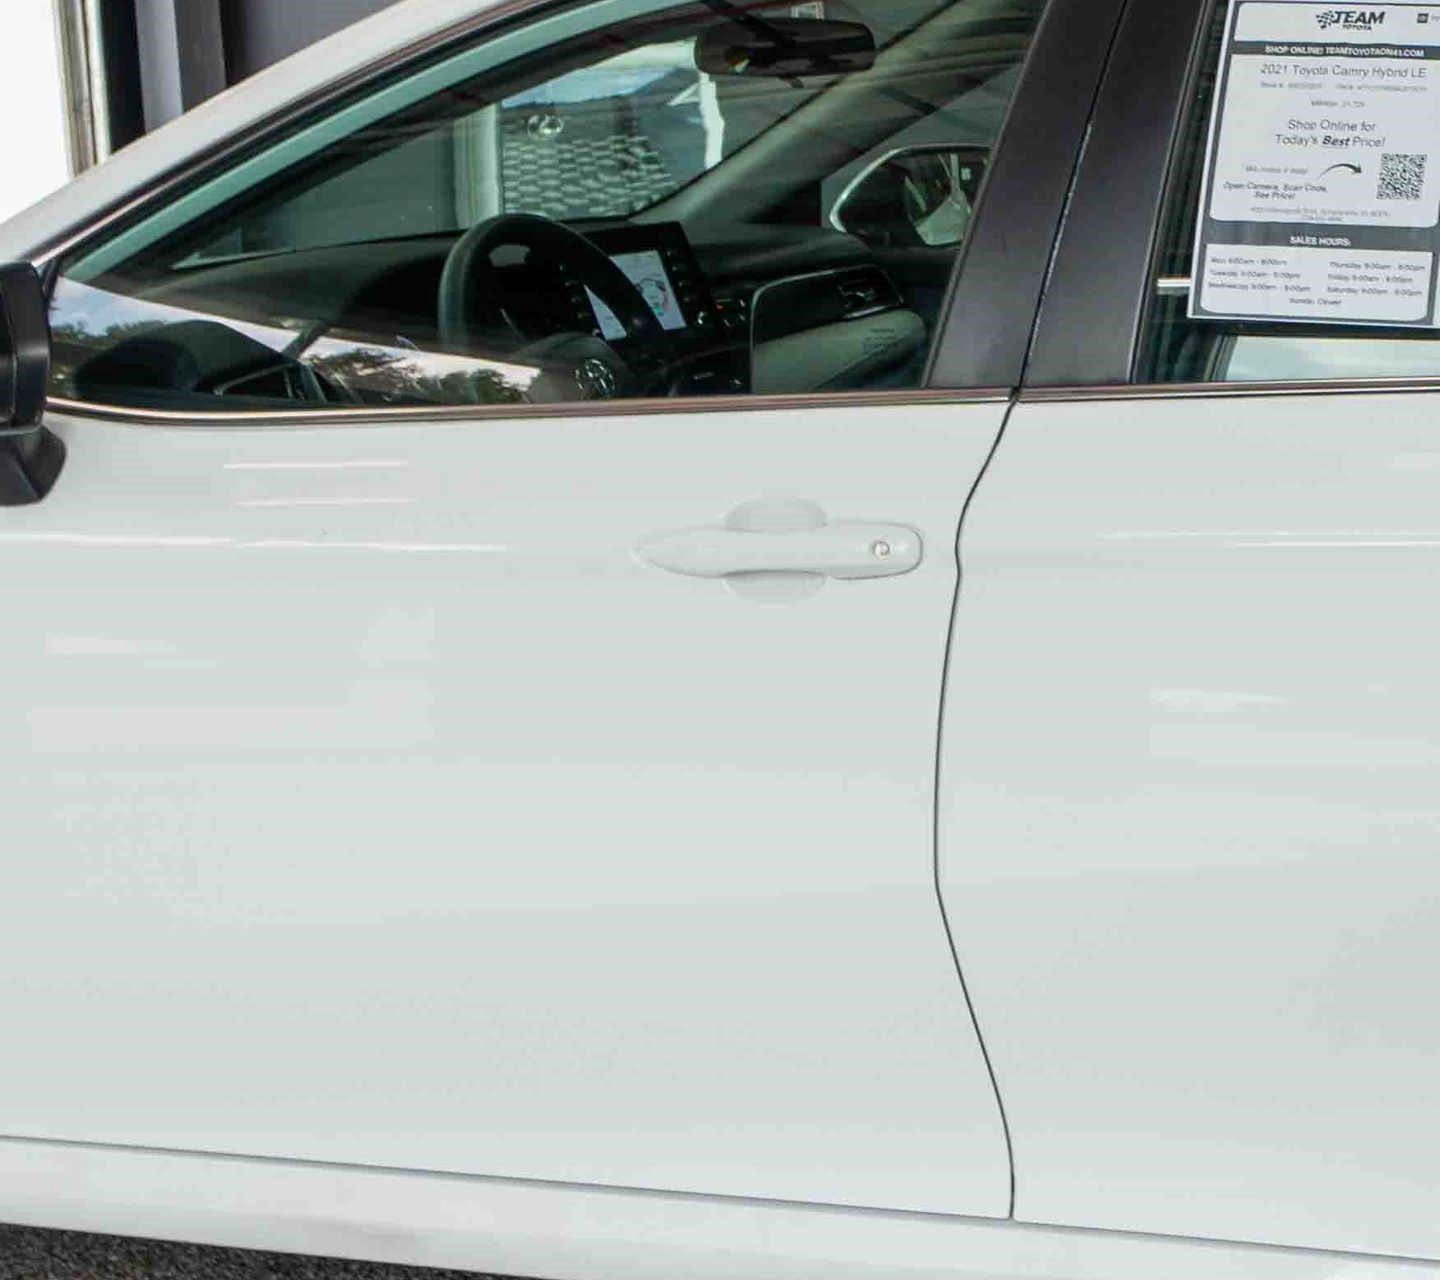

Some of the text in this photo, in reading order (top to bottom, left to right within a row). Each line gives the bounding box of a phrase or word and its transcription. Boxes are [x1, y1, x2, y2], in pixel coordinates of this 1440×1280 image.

[1332, 10, 1386, 24] TEAM
[1265, 45, 1289, 54] SHOP
[1260, 63, 1427, 79] 2021 Toyota Camry Hybrid LE
[1288, 119, 1376, 132] Shop Online for
[1275, 134, 1386, 148] Today's Best Price!
[1223, 182, 1245, 191] Open
[1282, 183, 1303, 191] Scan
[1255, 191, 1269, 200] See
[1290, 235, 1317, 246] SALES
